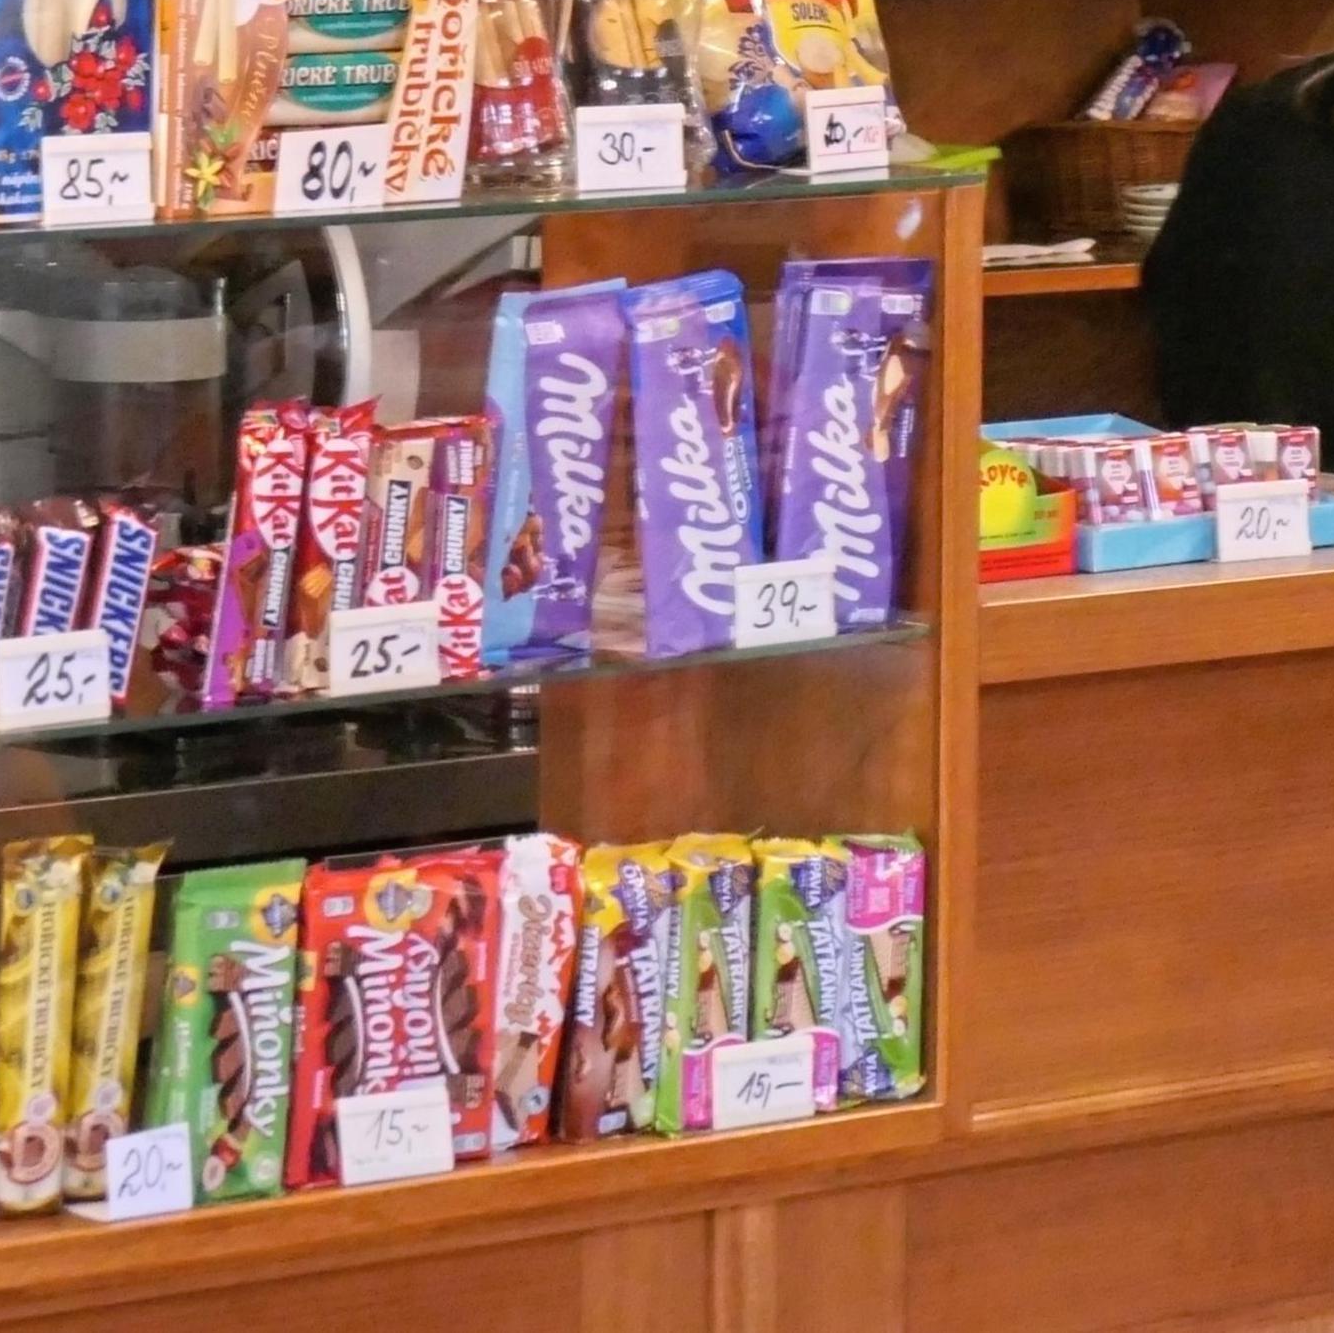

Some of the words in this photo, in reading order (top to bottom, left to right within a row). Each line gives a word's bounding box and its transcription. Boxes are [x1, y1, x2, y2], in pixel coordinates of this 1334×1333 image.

[384, 18, 438, 195] trubičky
[597, 130, 658, 173] 30,-
[252, 448, 304, 550] KitKat
[309, 448, 369, 561] KitKat
[534, 351, 609, 563] Milka
[659, 392, 745, 617] Milka
[806, 371, 884, 603] Milka
[383, 480, 411, 566] CHUNKY
[446, 496, 468, 574] CHUNKY
[264, 549, 292, 628] CHUNKY
[23, 651, 97, 708] 25,-
[344, 925, 406, 1099] Minonk
[575, 925, 600, 1029] TATRANKY
[721, 922, 749, 1029] TATRANKY
[807, 914, 837, 1022] TATRANKY
[849, 939, 879, 1045] TATRANKY
[229, 940, 294, 1141] Minonky
